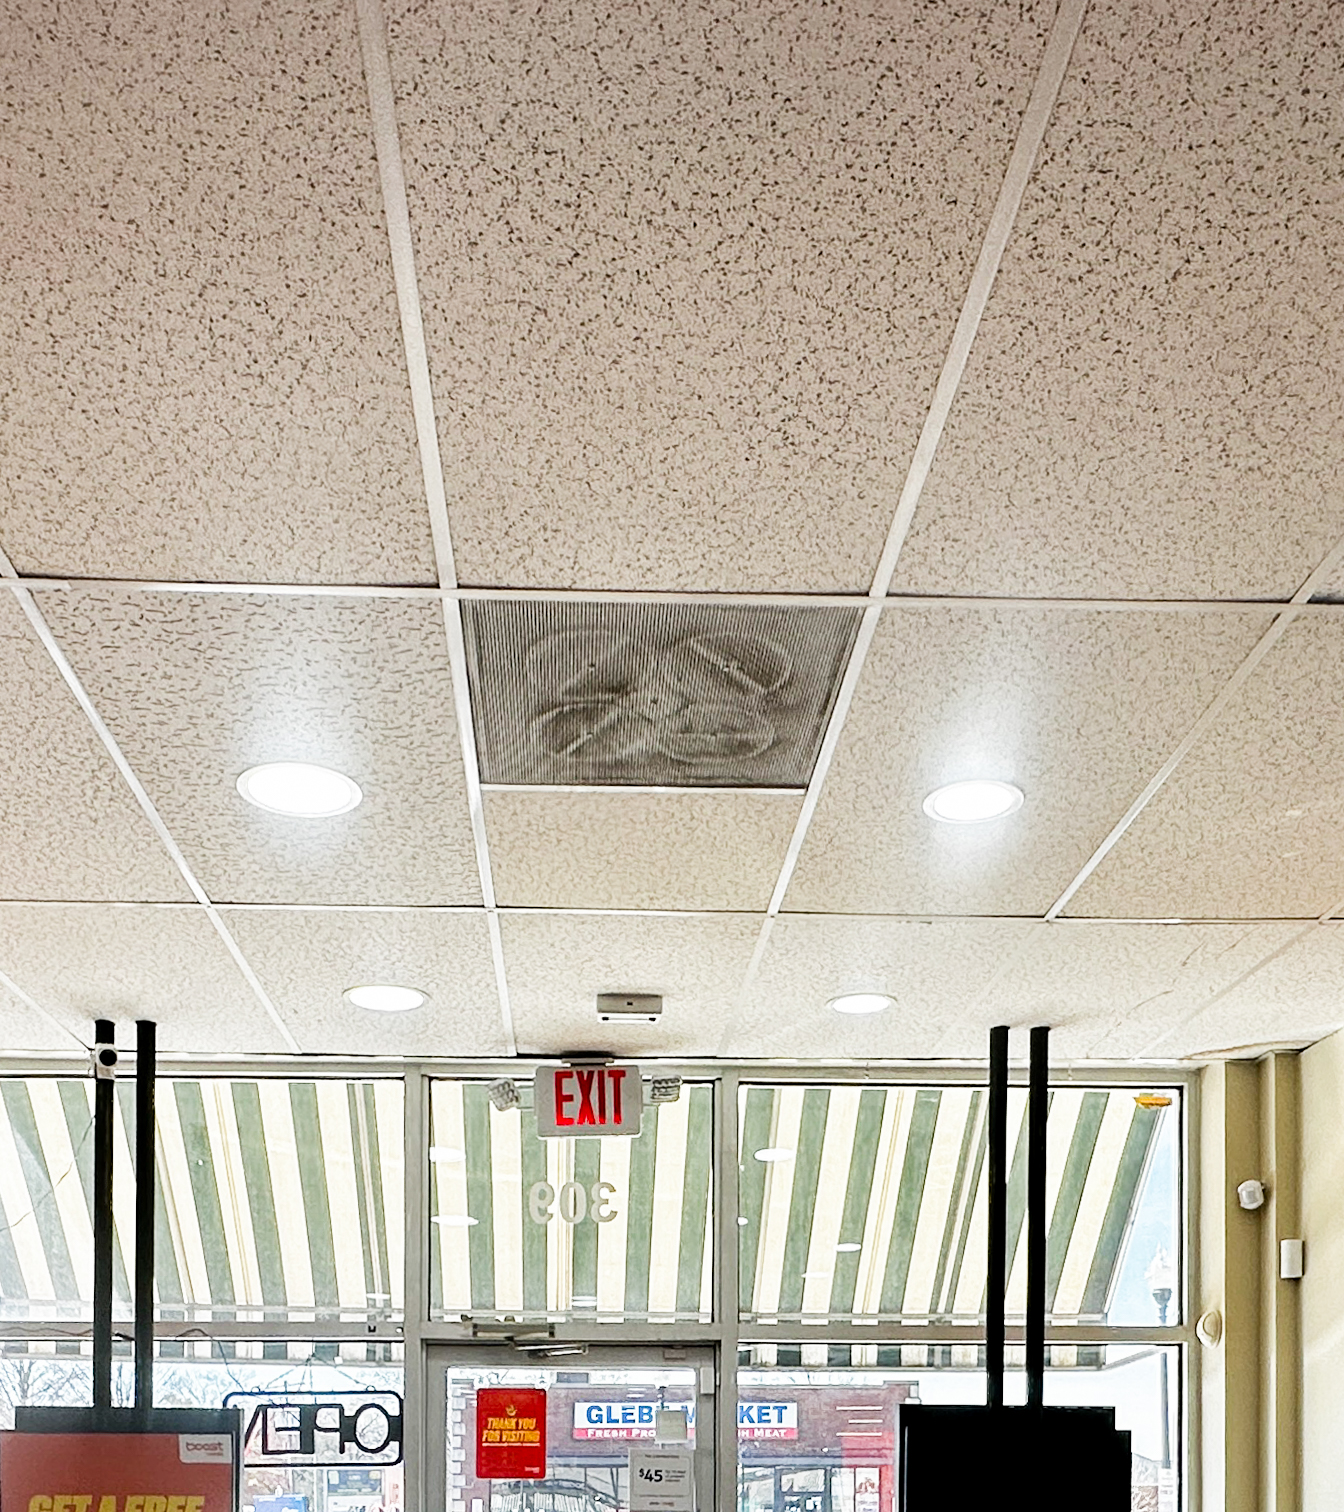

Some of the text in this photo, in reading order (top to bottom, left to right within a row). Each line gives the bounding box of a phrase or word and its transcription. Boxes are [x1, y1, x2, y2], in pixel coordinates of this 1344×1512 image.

[555, 1070, 626, 1126] EXIT
[586, 1405, 669, 1424] GLEB
[518, 1418, 536, 1430] YOU
[587, 1428, 627, 1438] FRESH
[754, 1428, 787, 1438] MEAT
[186, 1441, 223, 1451] boost
[639, 1468, 663, 1482] $45
